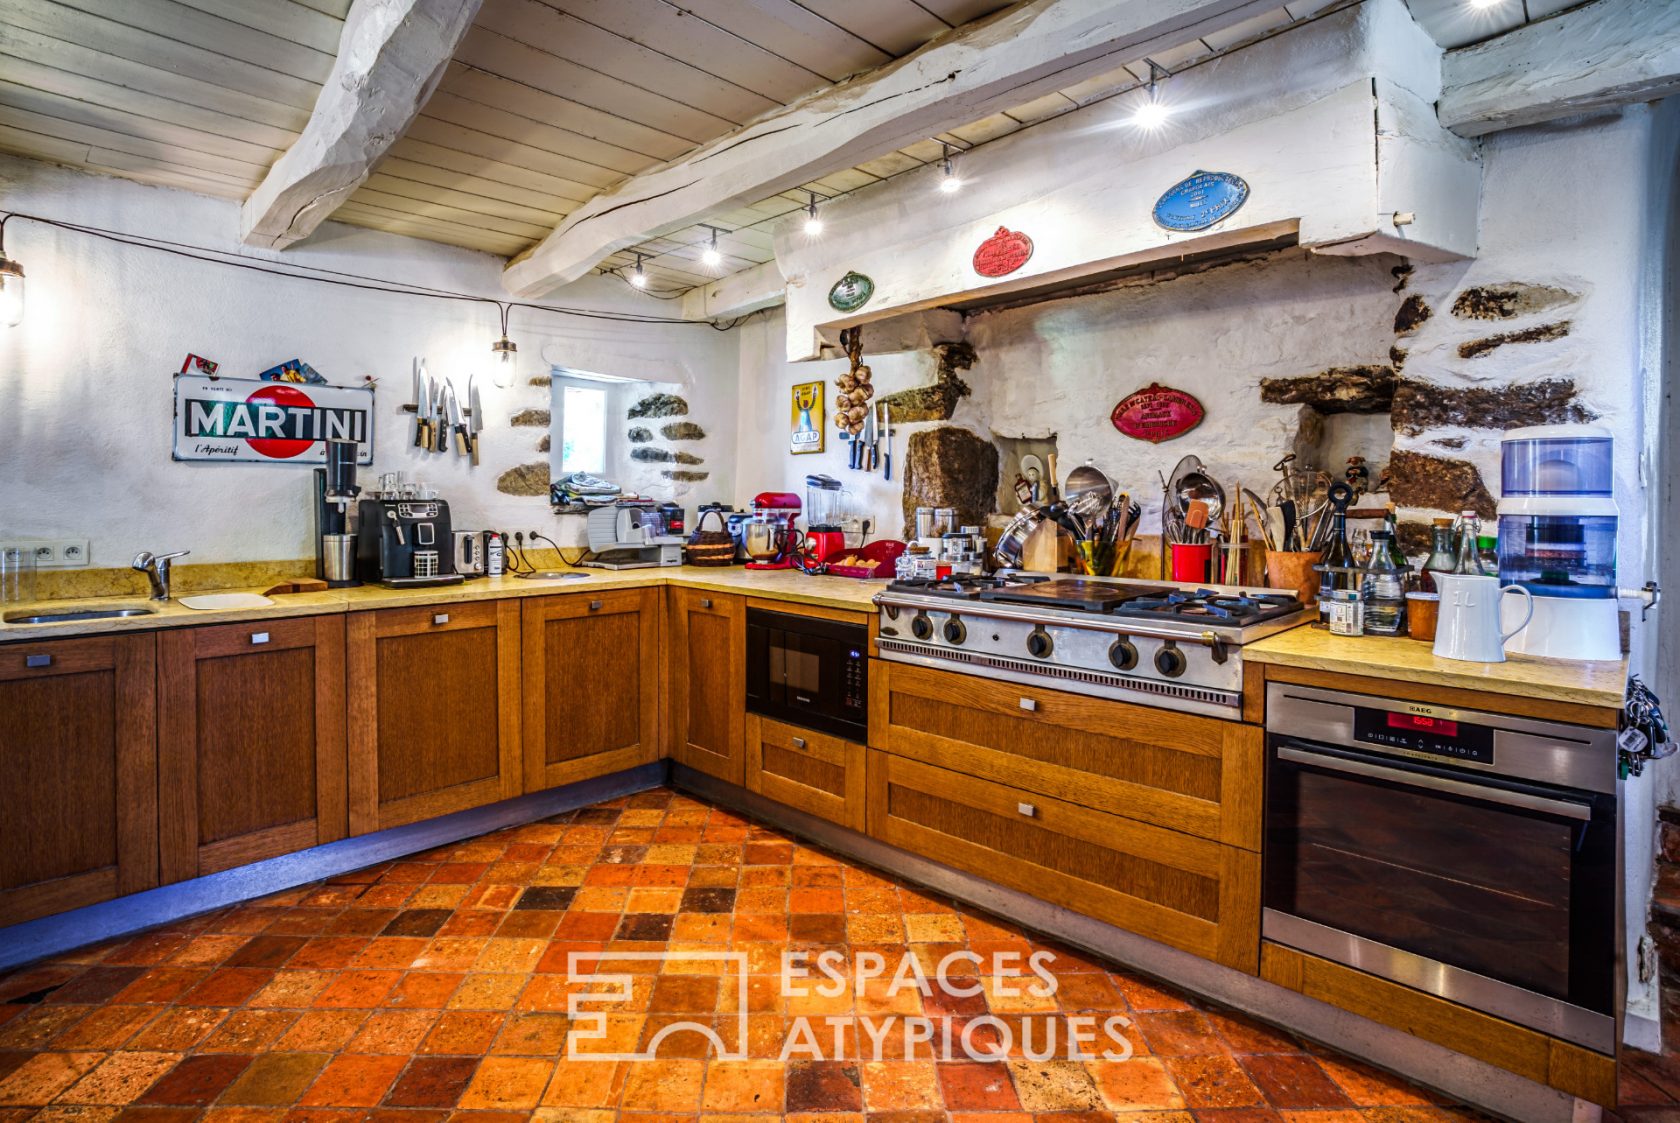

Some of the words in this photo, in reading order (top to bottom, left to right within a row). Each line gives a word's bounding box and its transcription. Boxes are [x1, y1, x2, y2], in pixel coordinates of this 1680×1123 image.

[190, 401, 362, 441] MARTINI
[194, 444, 239, 456] l'Apéritif
[1416, 706, 1432, 714] AEG
